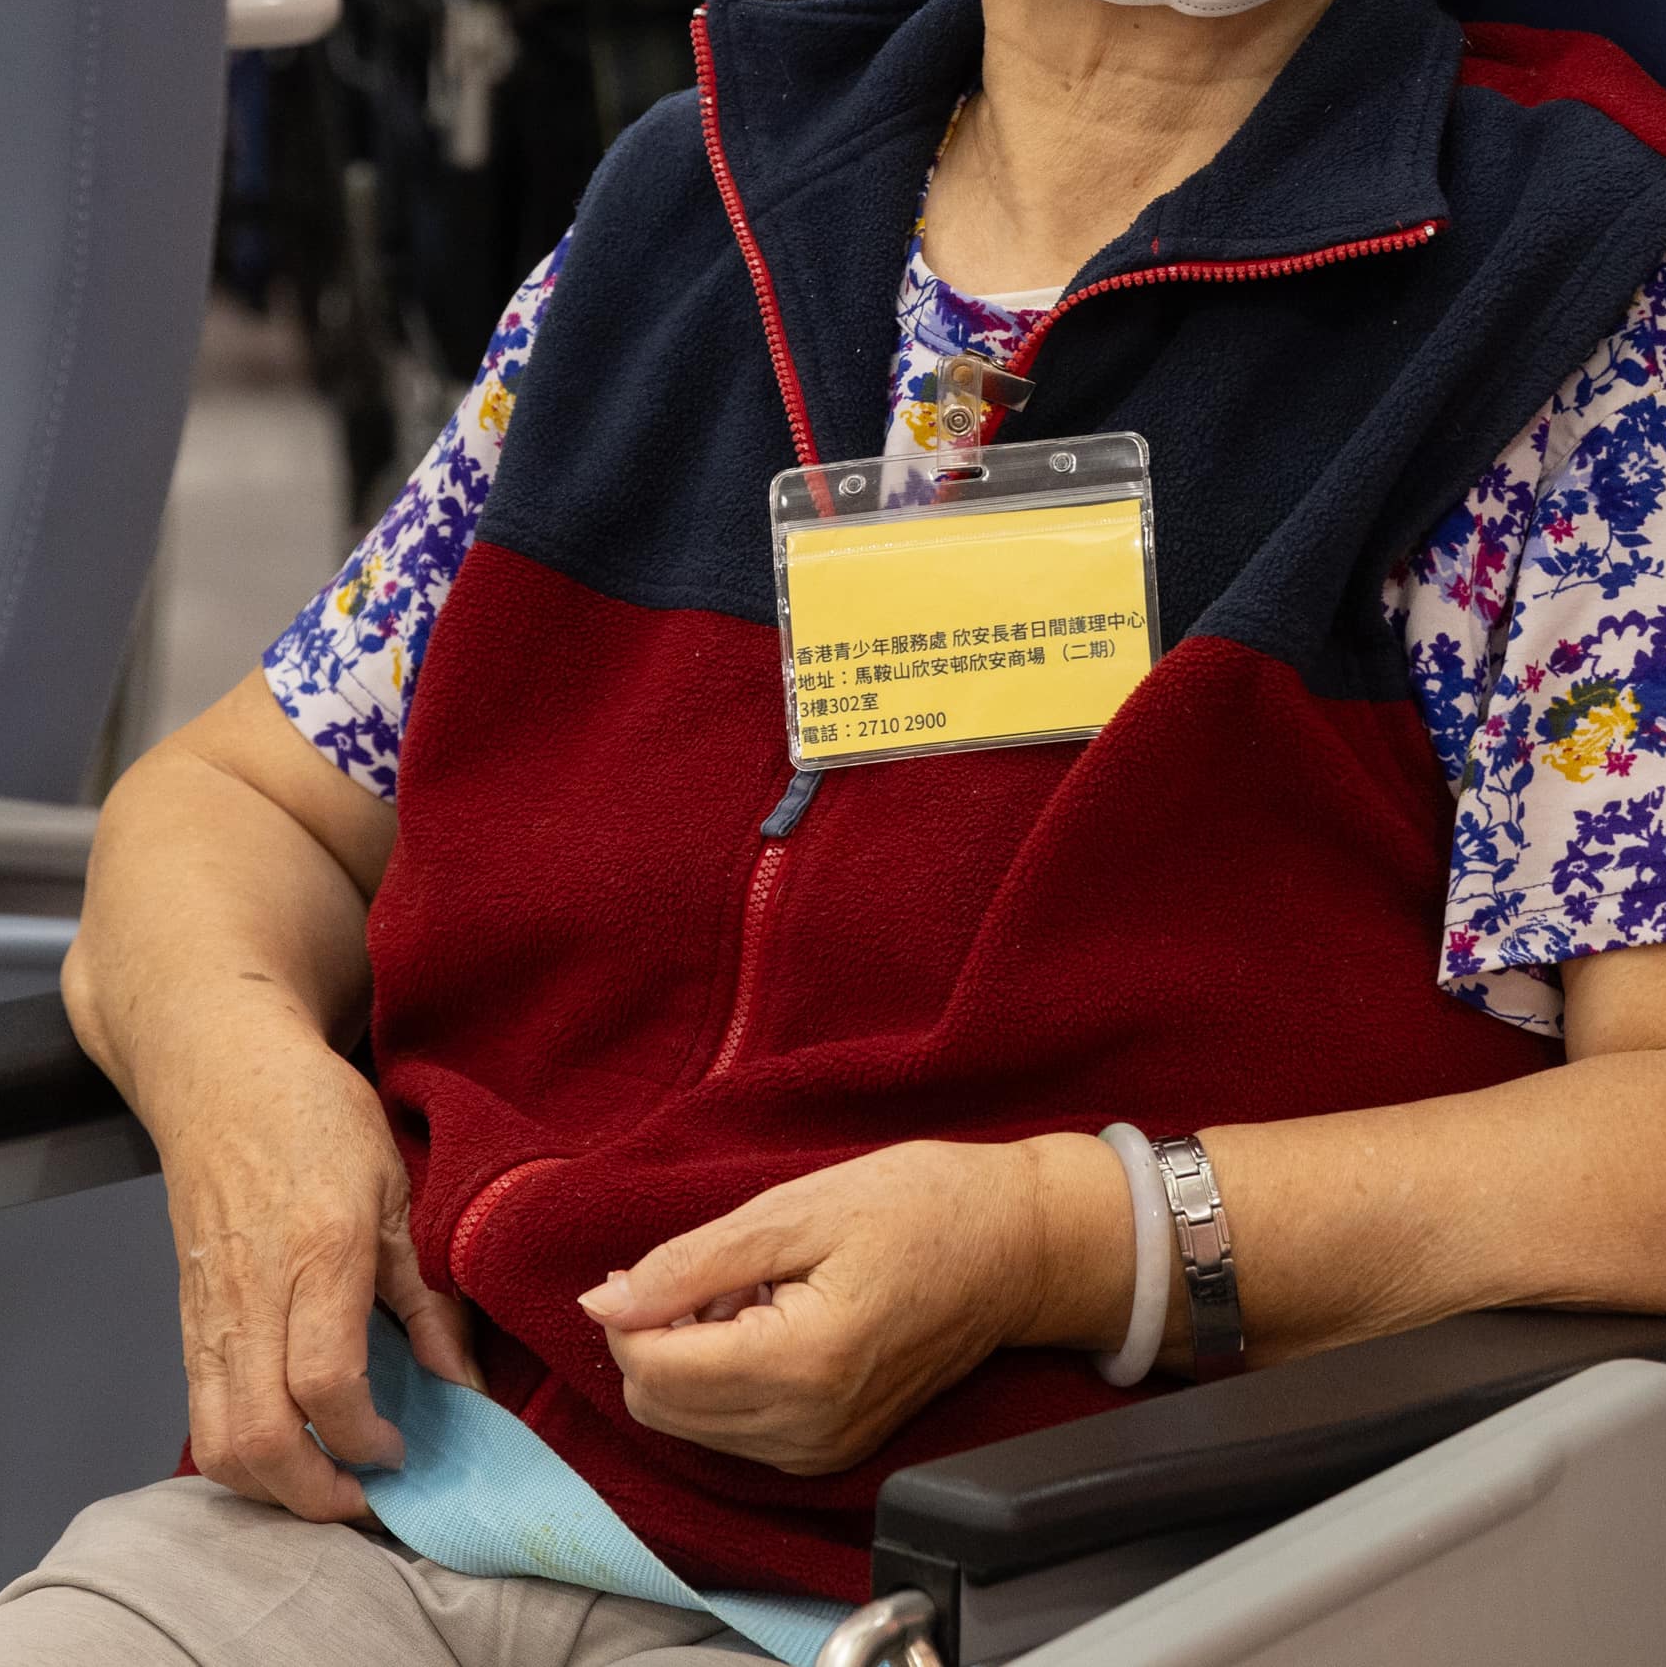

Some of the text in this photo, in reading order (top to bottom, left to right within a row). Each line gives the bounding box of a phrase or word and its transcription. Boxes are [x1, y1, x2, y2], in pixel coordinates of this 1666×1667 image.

[796, 611, 1146, 666] 香港青少年服務處 欣安長者日間護理中心
[800, 692, 880, 718] 3樓302室
[904, 711, 947, 732] 2900
